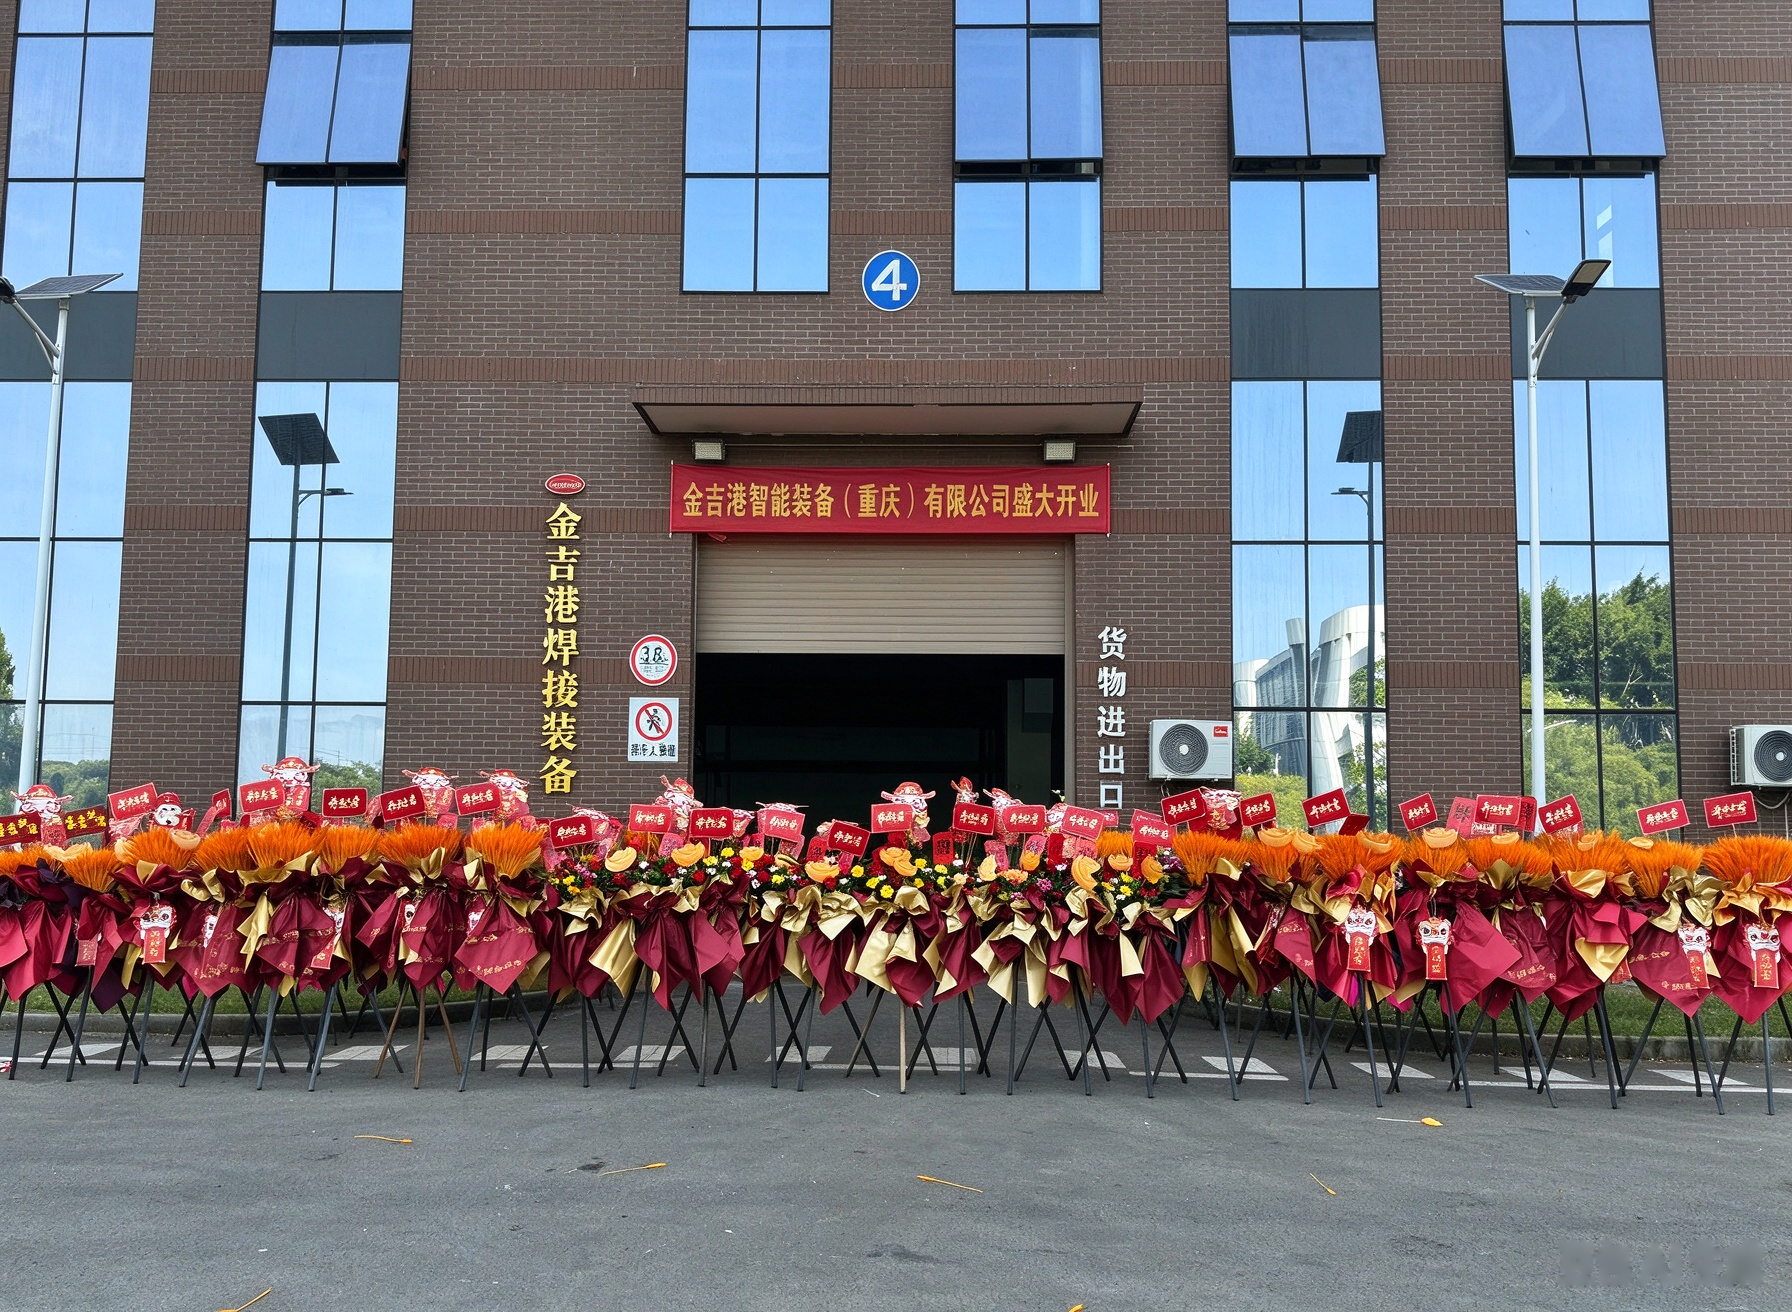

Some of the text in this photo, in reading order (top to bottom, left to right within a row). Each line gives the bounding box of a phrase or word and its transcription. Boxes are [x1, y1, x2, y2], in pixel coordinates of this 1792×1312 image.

[871, 258, 907, 301] 4
[683, 481, 1099, 520] 金吉港智能装备（重庆）有限公司盛大开业
[539, 502, 582, 794] 金吉港焊接装备
[1097, 626, 1127, 809] 货物进出口
